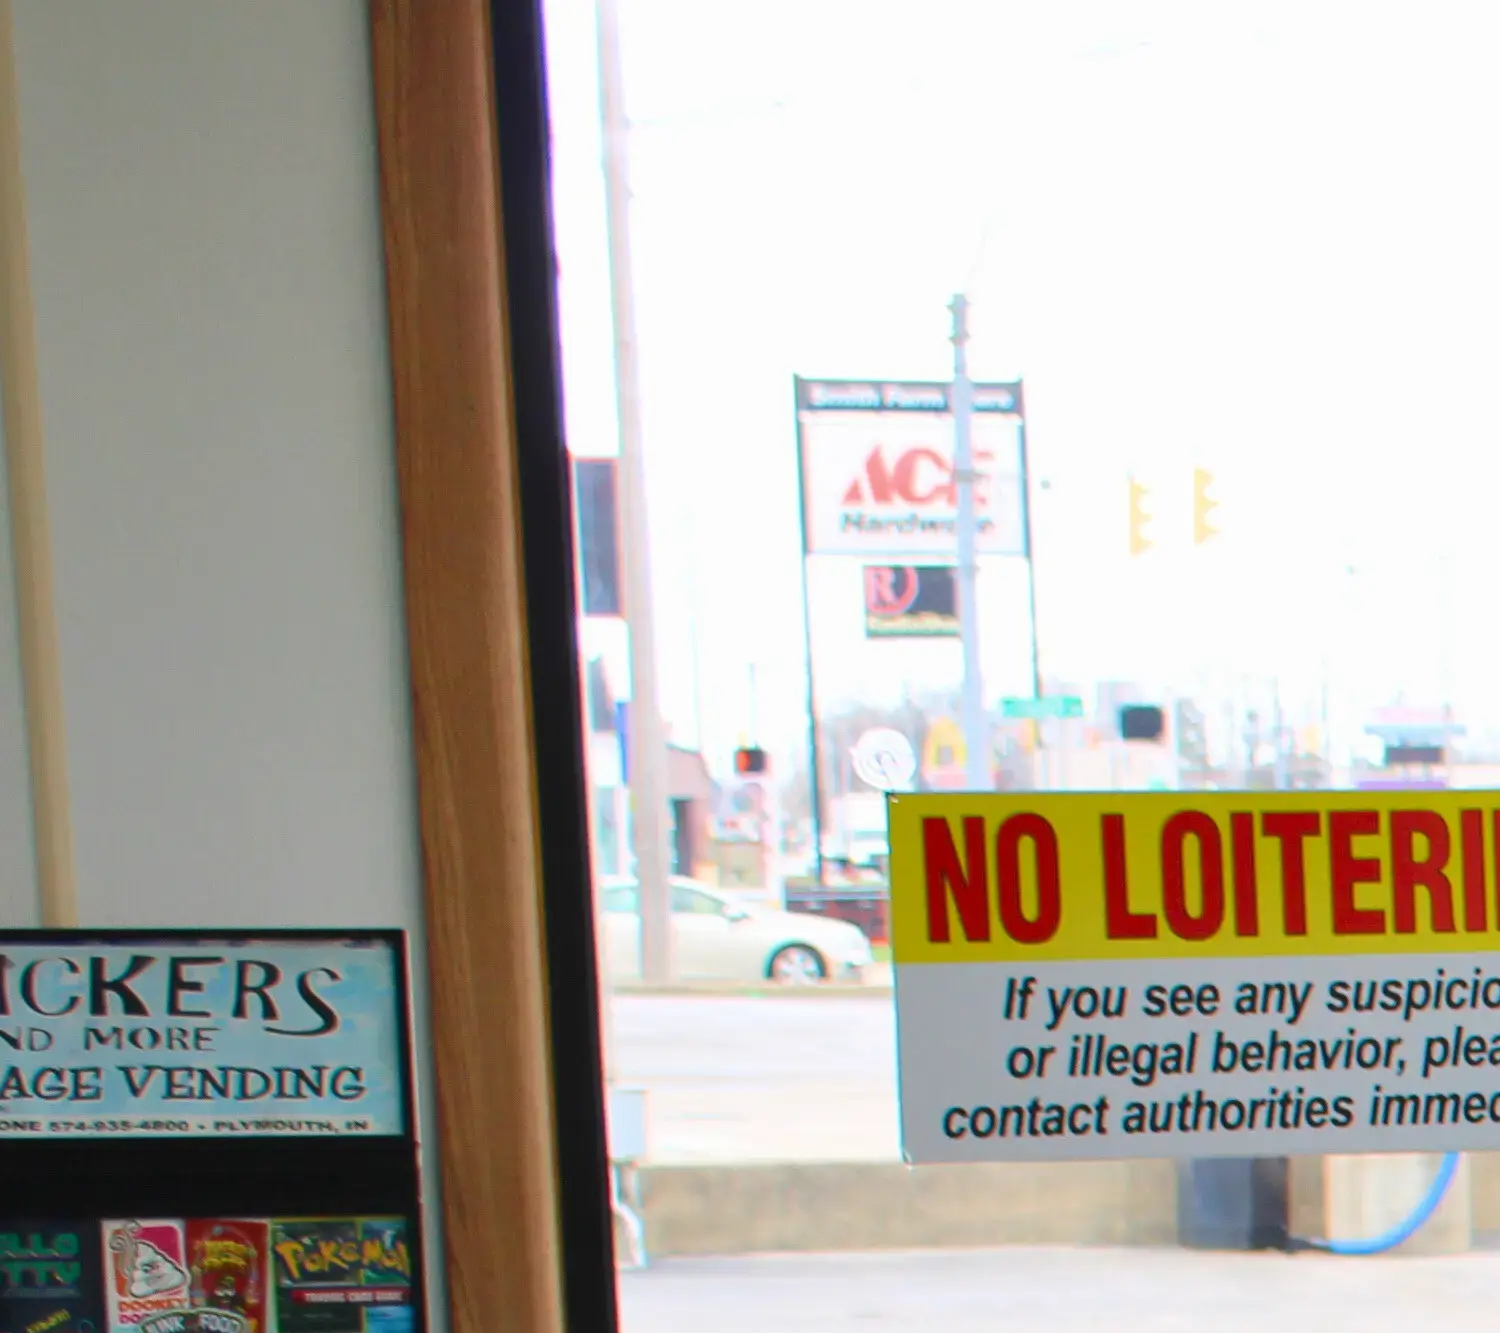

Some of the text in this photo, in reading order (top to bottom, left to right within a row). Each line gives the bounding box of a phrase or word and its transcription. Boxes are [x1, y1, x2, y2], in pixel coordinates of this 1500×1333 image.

[921, 812, 1061, 945] NO
[1004, 976, 1038, 1021] If
[1044, 985, 1127, 1030] you
[1142, 980, 1220, 1017] see
[1233, 978, 1314, 1027] any
[84, 1026, 221, 1053] MORE
[1006, 1043, 1056, 1078] or
[1068, 1031, 1199, 1087] illegal
[1211, 1030, 1407, 1079] behavior,
[117, 1064, 368, 1101] VENDING
[942, 1093, 1108, 1140] contact
[1122, 1085, 1354, 1136] authorities
